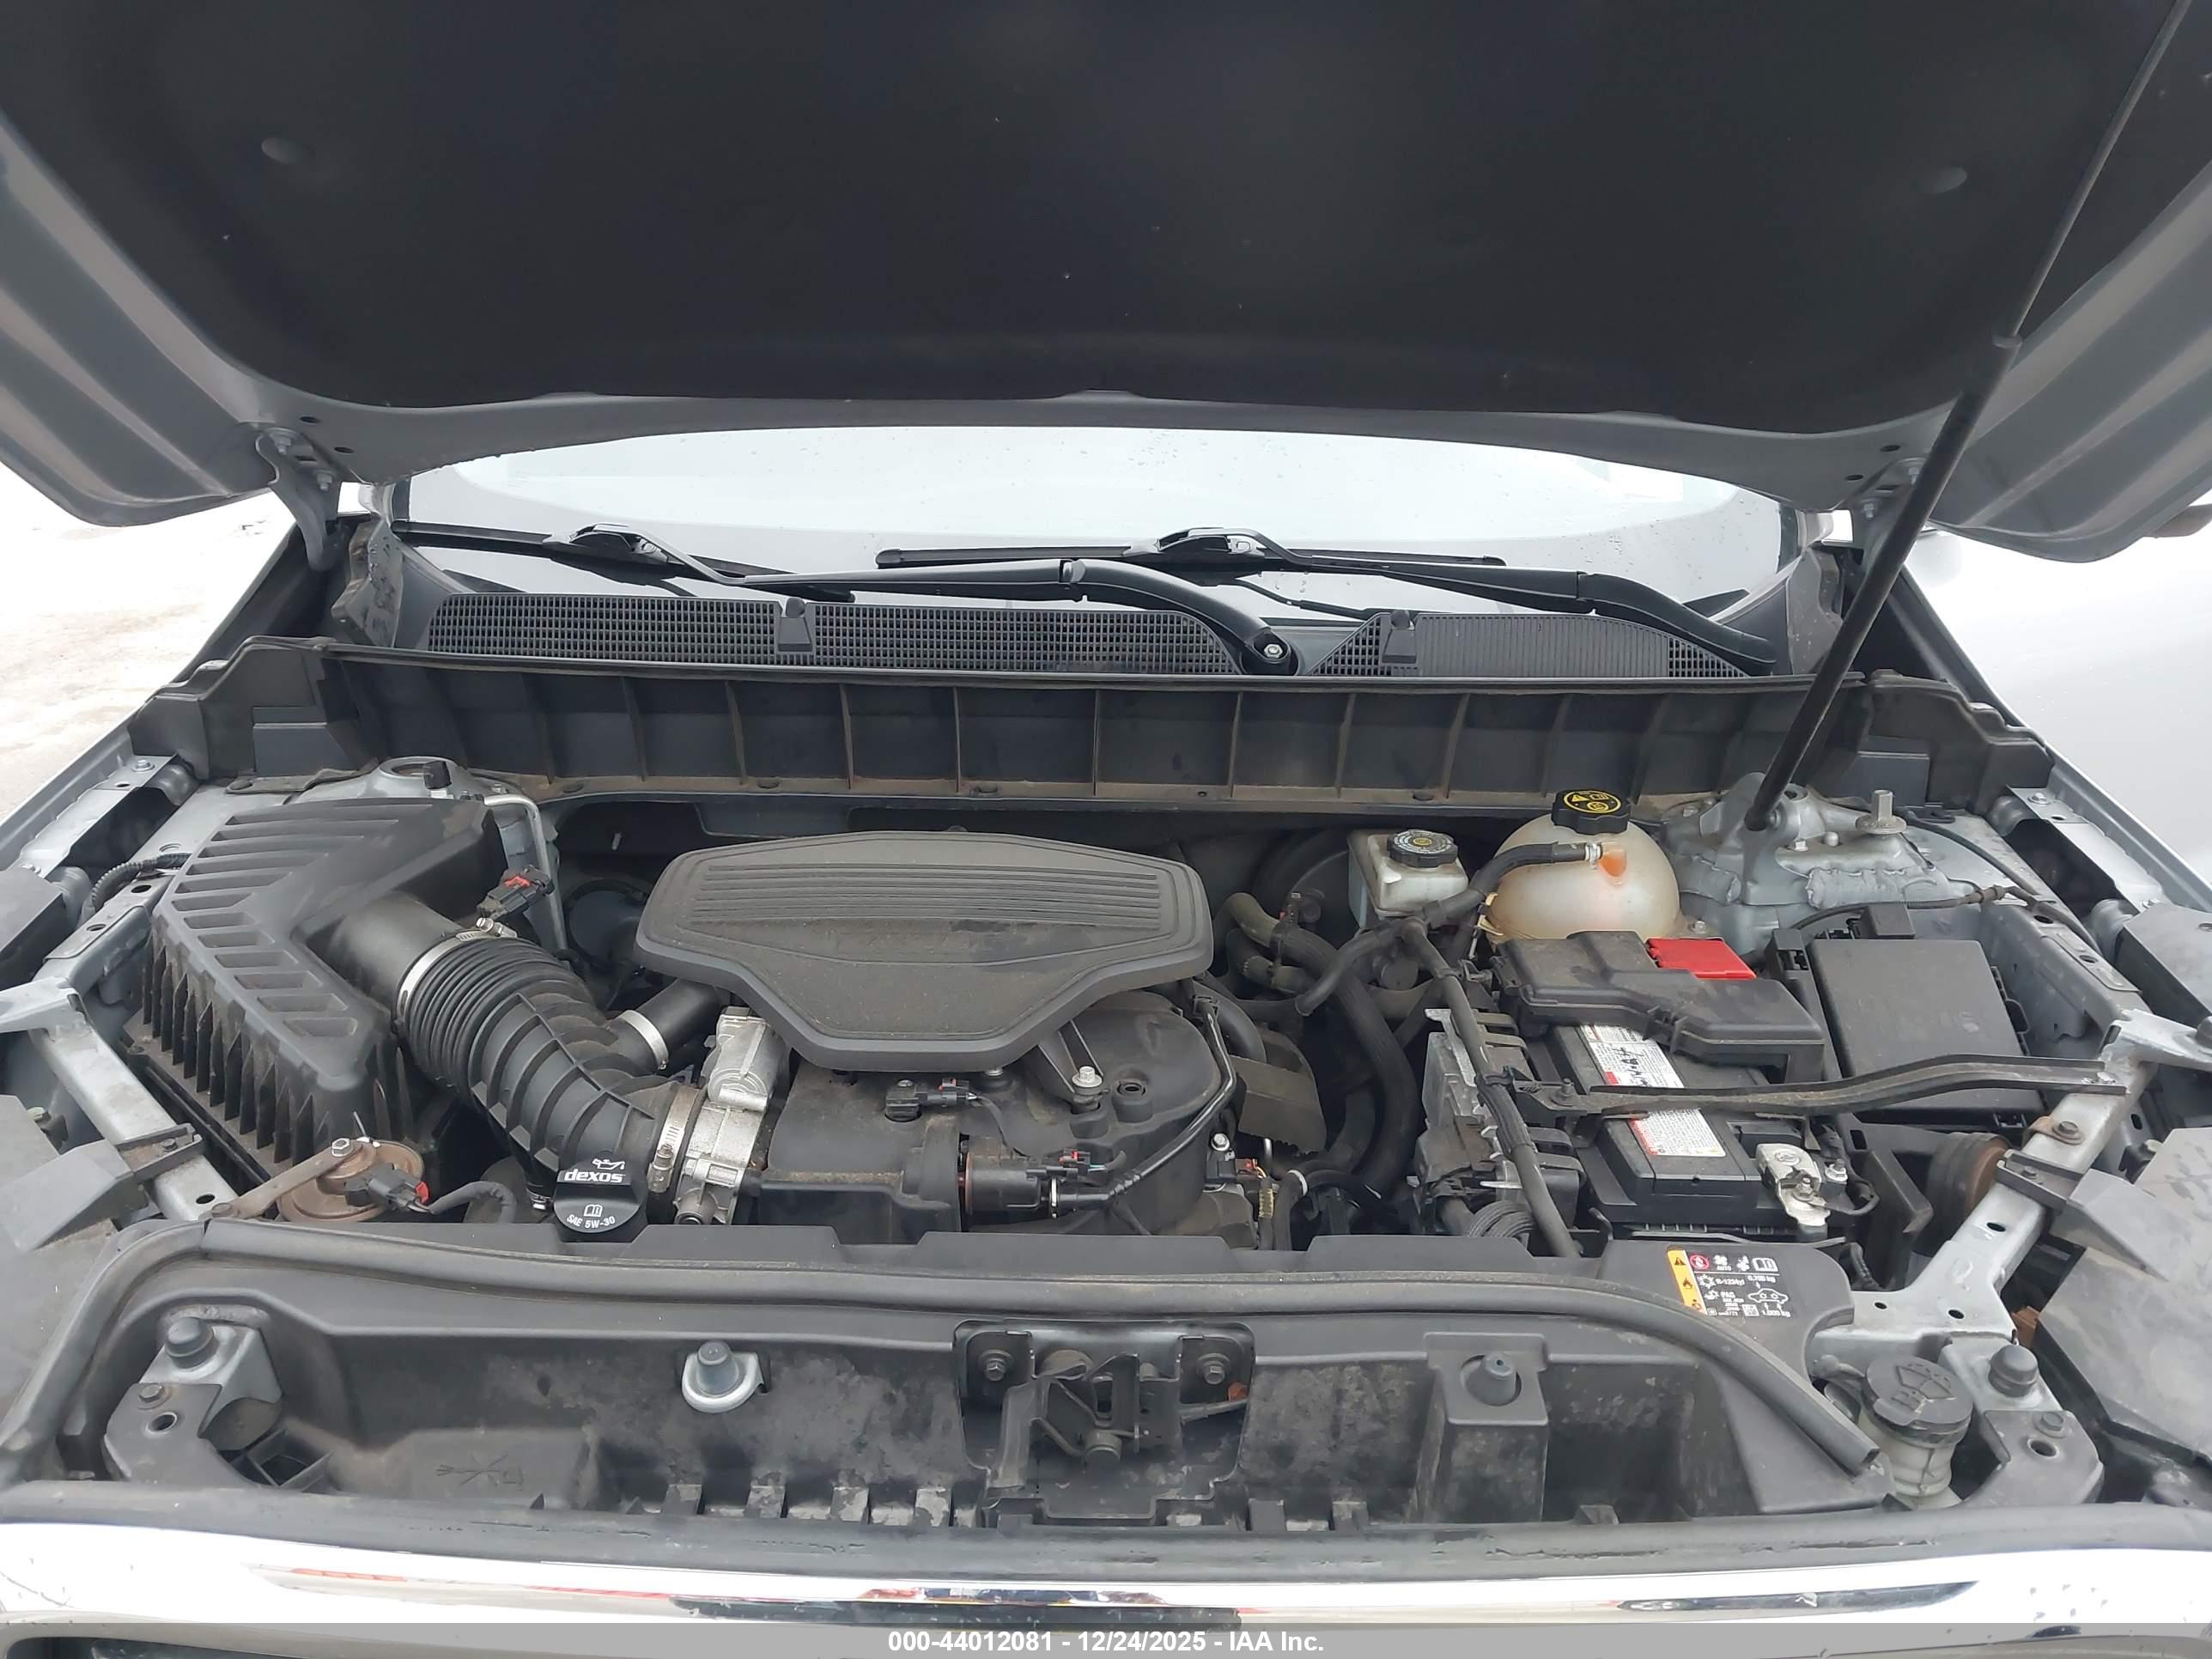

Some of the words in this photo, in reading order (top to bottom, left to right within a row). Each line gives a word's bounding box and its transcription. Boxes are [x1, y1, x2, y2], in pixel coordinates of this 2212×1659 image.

[563, 1169, 623, 1183] dexos
[567, 1214, 582, 1227] SAE
[585, 1215, 616, 1229] 5W-30
